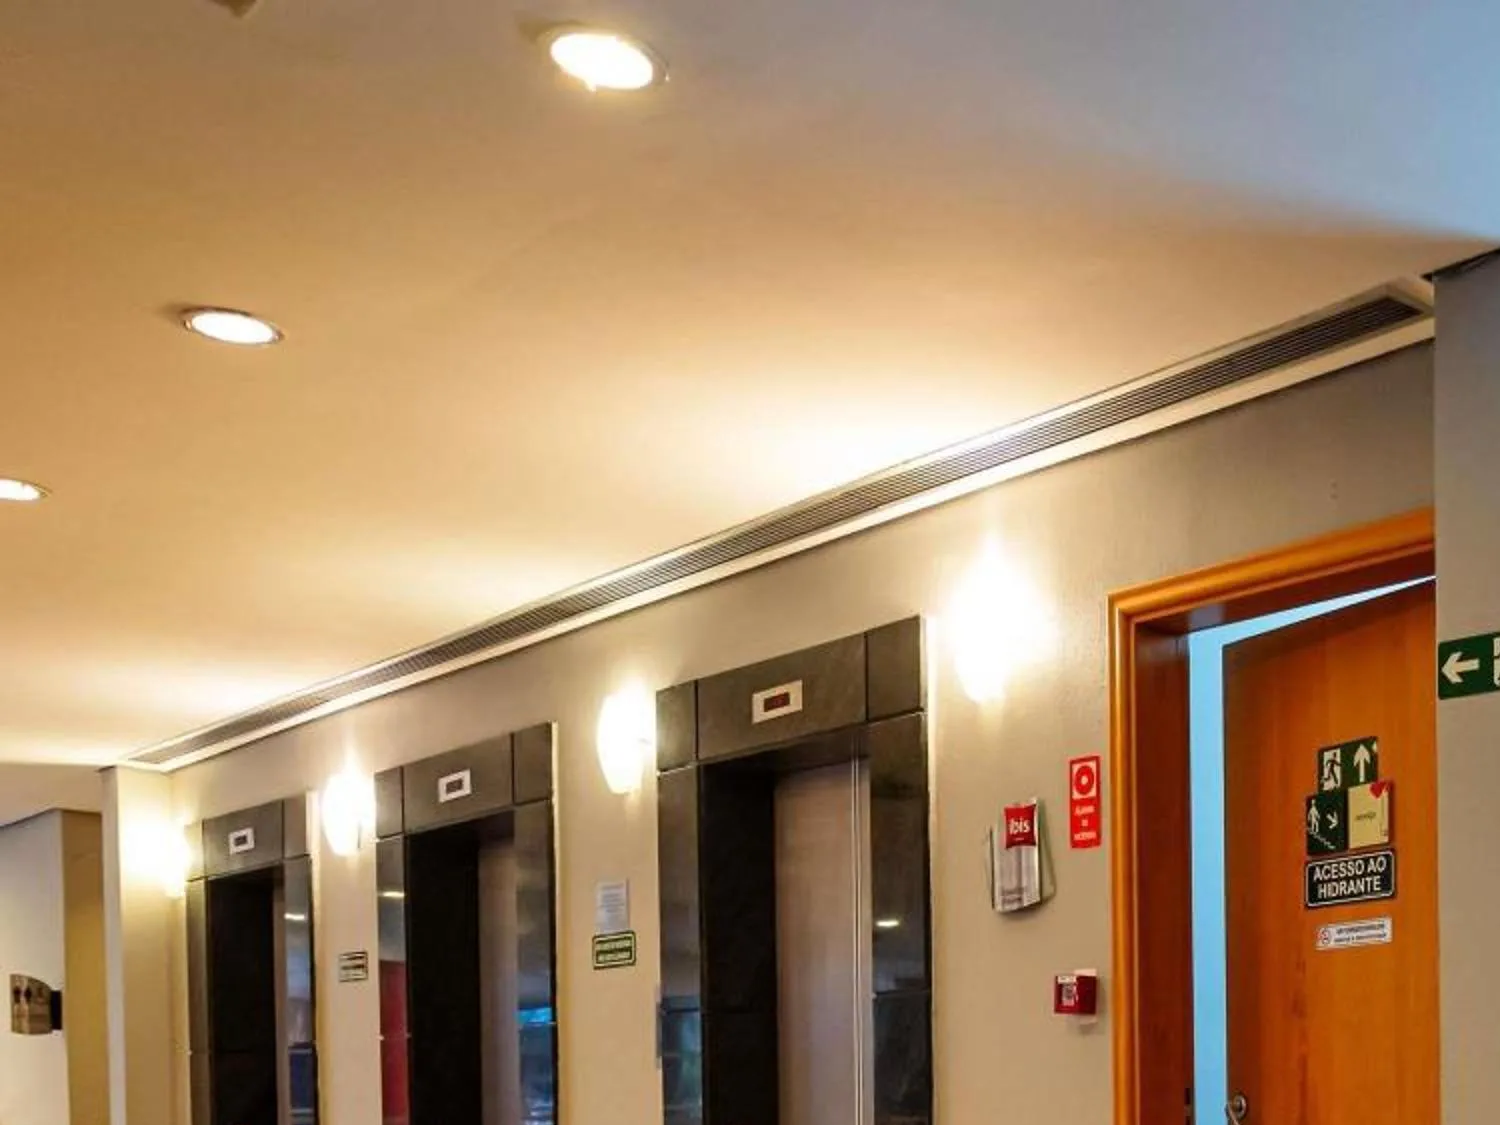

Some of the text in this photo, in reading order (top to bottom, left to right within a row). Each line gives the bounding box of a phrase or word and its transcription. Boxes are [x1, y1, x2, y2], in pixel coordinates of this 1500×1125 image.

[1008, 817, 1031, 836] ibis
[1313, 856, 1388, 882] ACESSO AO
[1317, 876, 1382, 898] HIDRANTE
